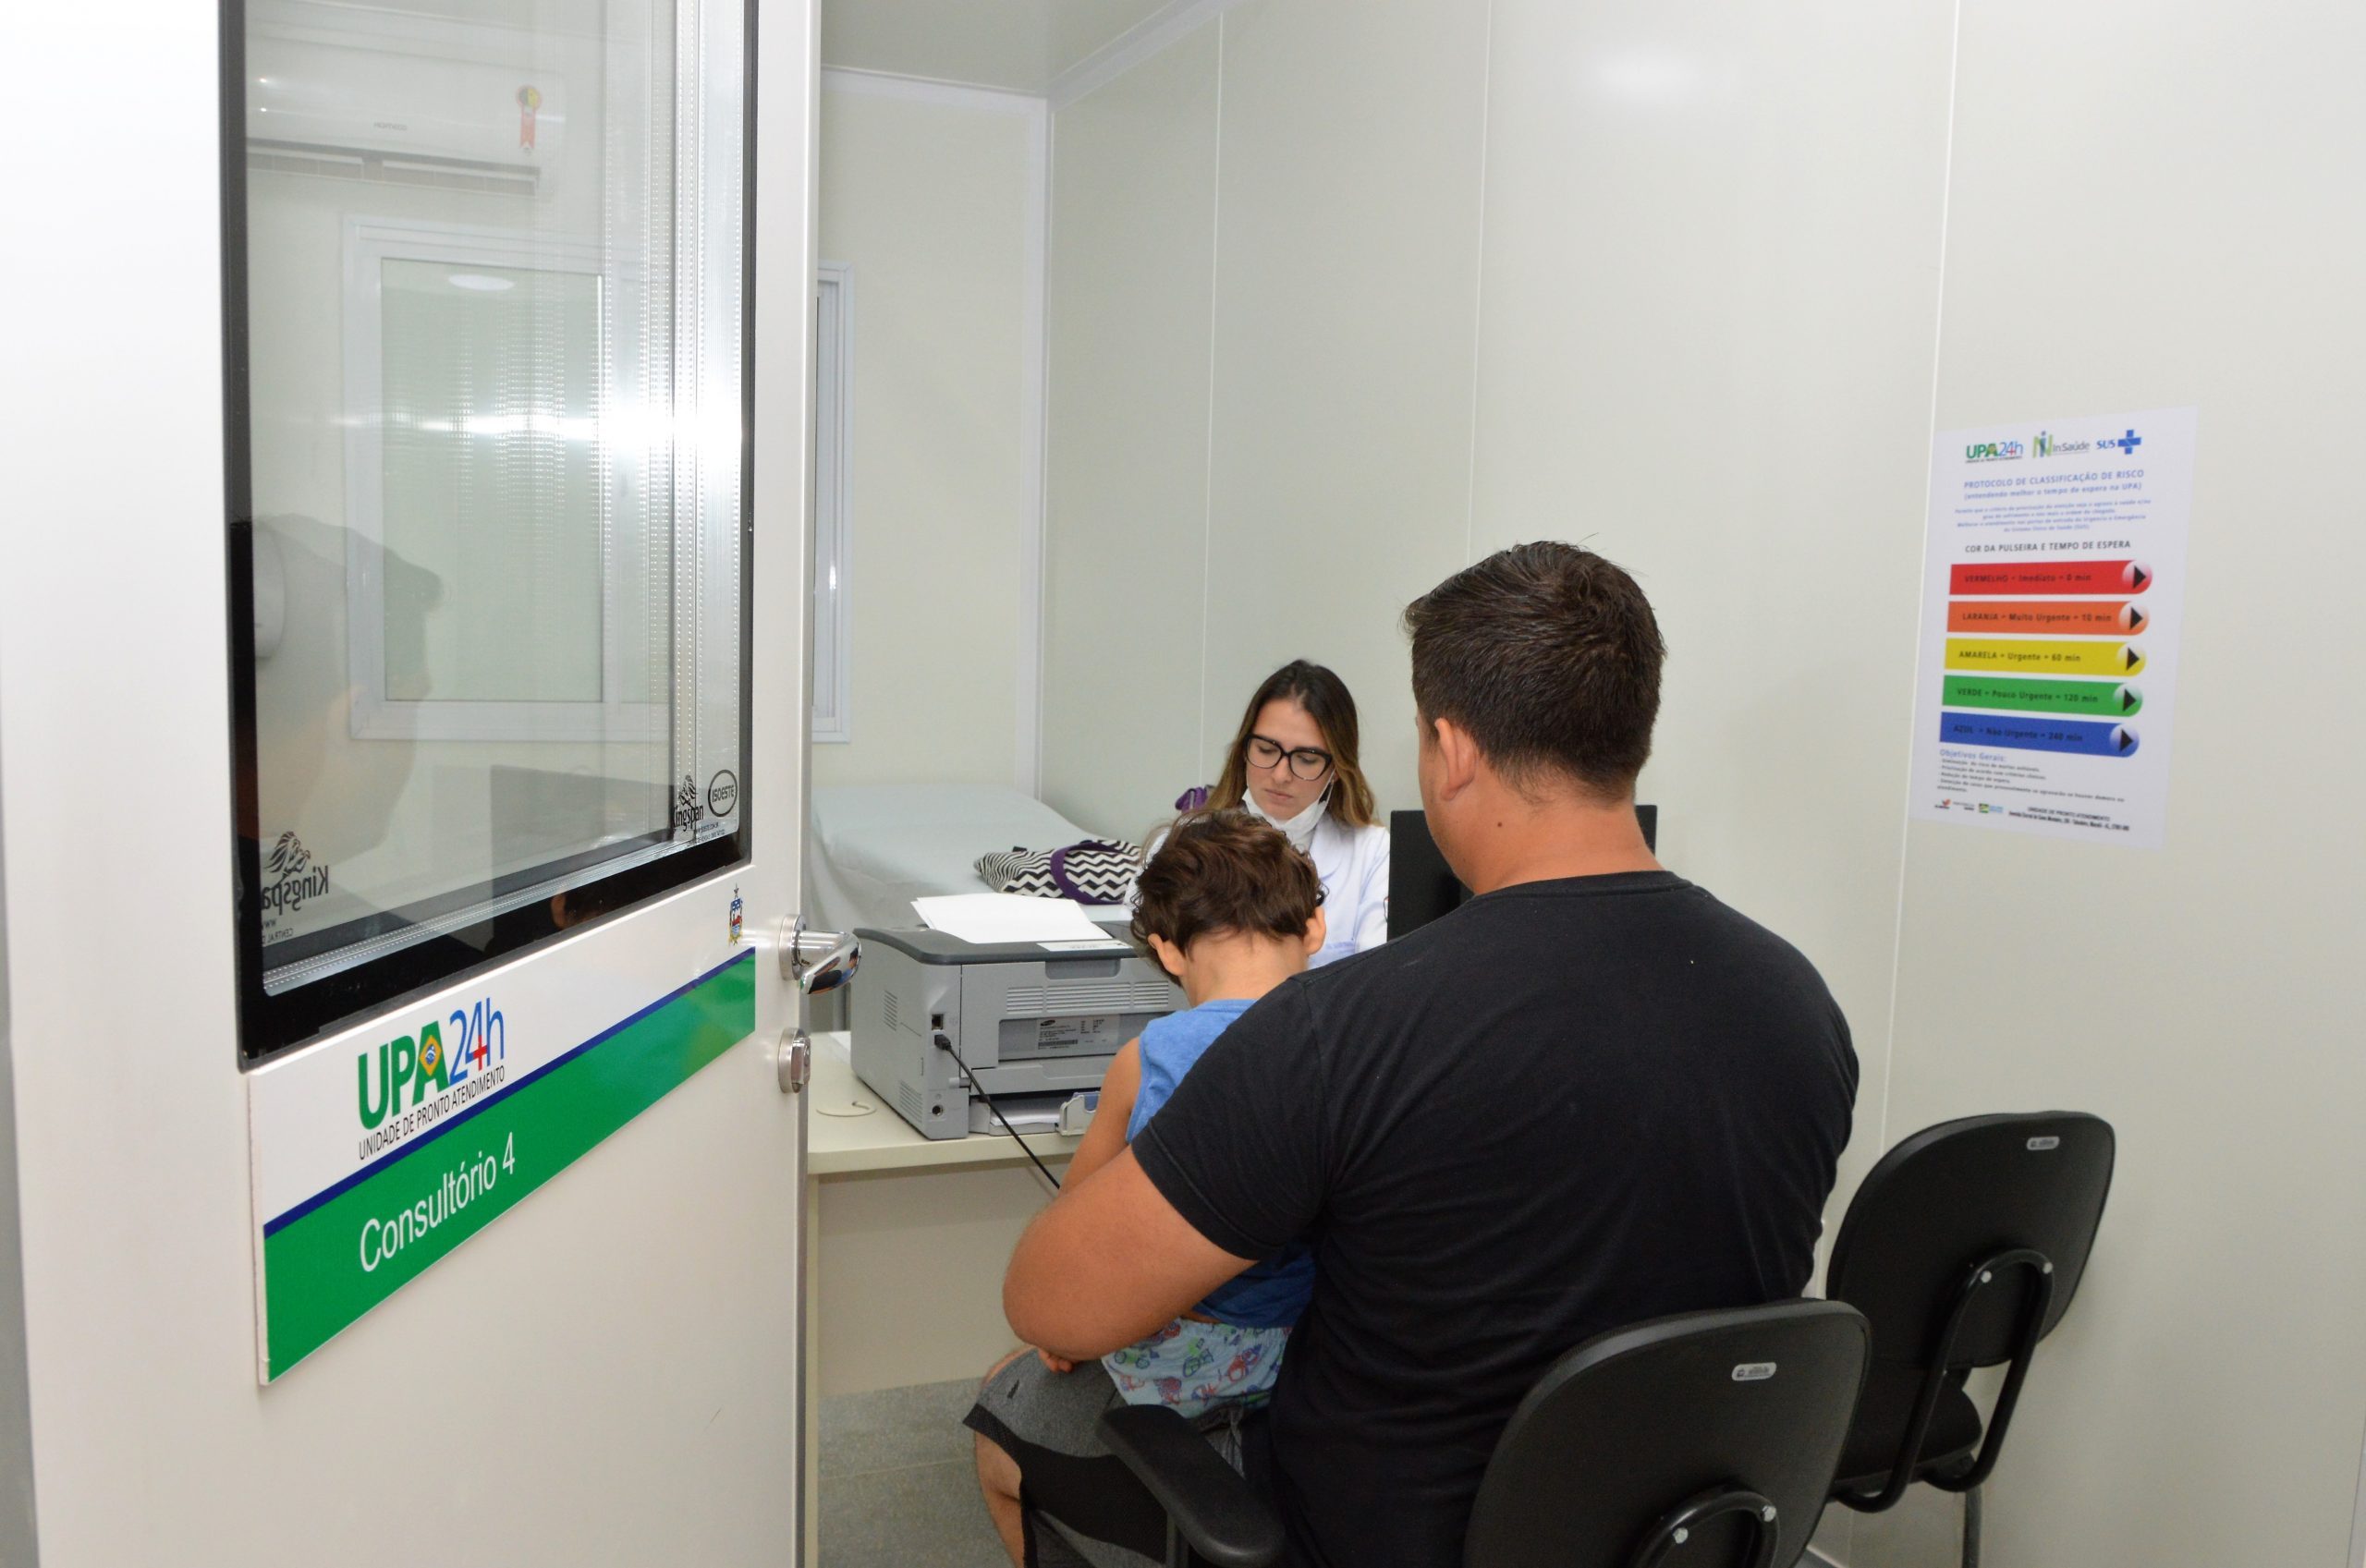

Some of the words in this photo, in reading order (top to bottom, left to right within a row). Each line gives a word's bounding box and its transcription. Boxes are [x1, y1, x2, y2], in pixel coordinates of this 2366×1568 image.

[2096, 439, 2116, 450] SUS
[1964, 479, 2013, 488] PROTOCOLO
[2016, 478, 2027, 486] DE
[2030, 471, 2098, 485] CLASSIFICAÇÃO
[2101, 471, 2113, 480] DE
[2116, 469, 2144, 479] RISCO
[2122, 481, 2142, 491] UPA)
[1984, 544, 1995, 553] DA
[1998, 543, 2037, 553] PULSEIRA
[2049, 541, 2079, 551] TEMPO
[2082, 541, 2093, 549] DE
[2097, 541, 2131, 549] ESPERA
[2009, 613, 2033, 621] Muito
[2036, 614, 2071, 623] Urgente
[1958, 650, 1997, 659] AMARELA
[2007, 652, 2041, 662] Urgente
[2052, 653, 2062, 662] 60
[2064, 653, 2081, 662] min
[1957, 688, 1982, 697] VERDE
[1993, 690, 2016, 699] Pouco
[2019, 691, 2052, 701] Urgente
[2064, 693, 2079, 702] 120
[2081, 694, 2099, 703] min
[1953, 725, 1973, 734] AZUL
[1986, 727, 2002, 736] Não
[2005, 729, 2038, 739] Urgente
[2067, 732, 2083, 742] min
[1939, 749, 1976, 759] Objetivos
[1979, 752, 2006, 761] Gerais:
[712, 784, 735, 803] ISOESTE
[359, 1124, 401, 1161] UNIDADE
[403, 1113, 414, 1134] DE
[416, 1094, 450, 1126] PRONTO
[451, 1064, 506, 1111] ATENDIMENTO
[360, 1150, 497, 1272] Consultório
[502, 1131, 516, 1175] 4
